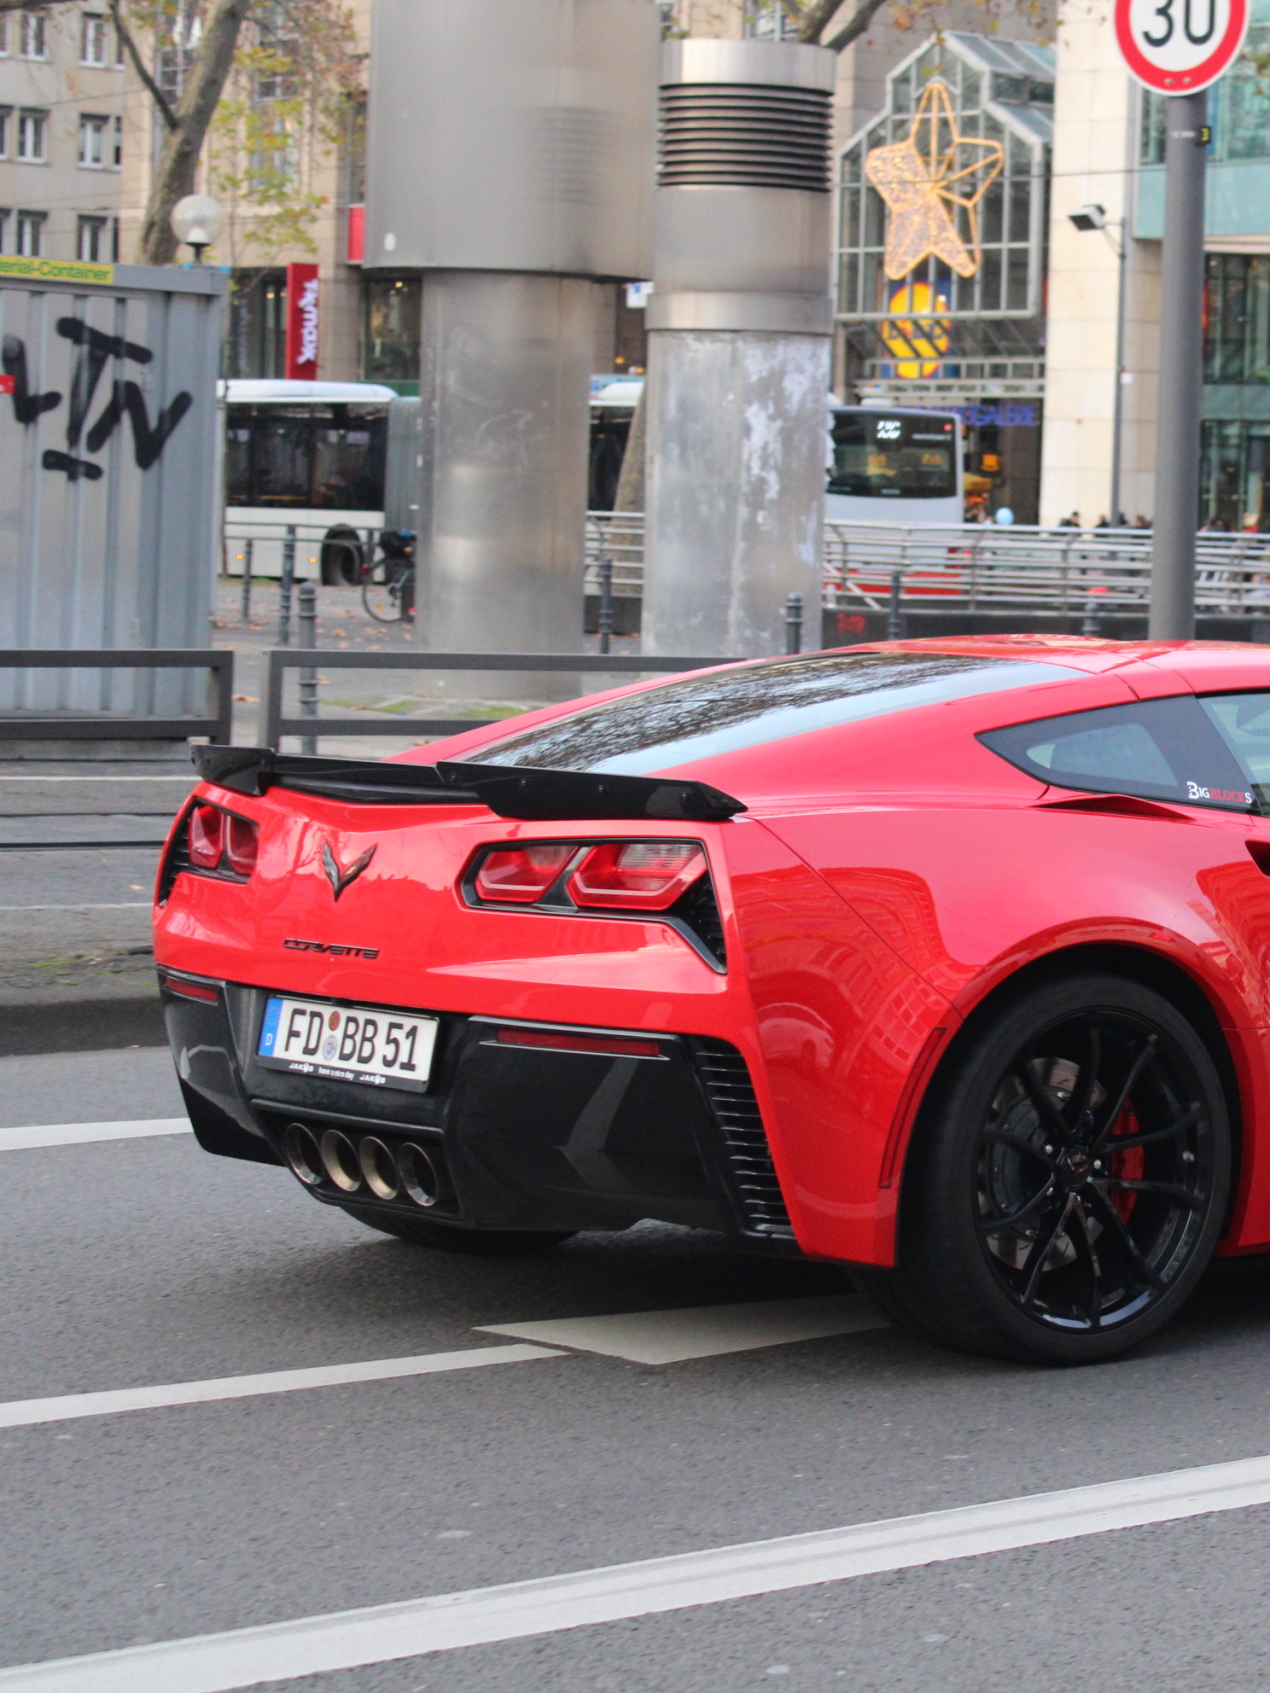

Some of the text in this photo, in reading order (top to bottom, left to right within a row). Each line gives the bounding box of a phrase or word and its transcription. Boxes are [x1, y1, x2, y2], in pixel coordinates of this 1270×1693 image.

[1142, 0, 1215, 48] 30
[283, 938, 379, 959] CORVETTE
[265, 1008, 418, 1071] D FD BB 51
